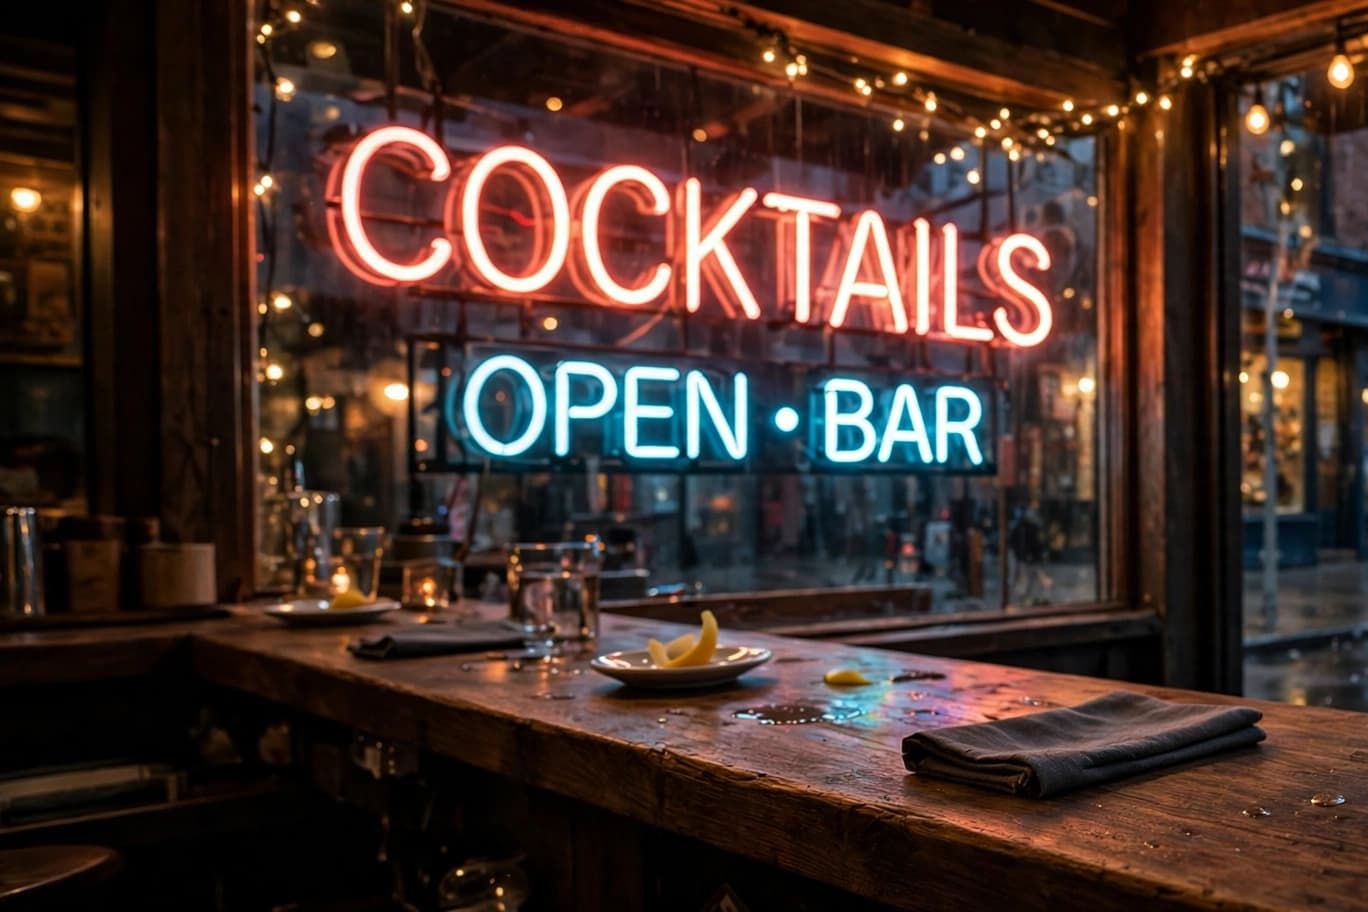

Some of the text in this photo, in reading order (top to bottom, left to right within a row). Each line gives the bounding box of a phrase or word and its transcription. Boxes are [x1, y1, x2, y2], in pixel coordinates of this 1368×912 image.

[335, 125, 1054, 348] COCKTAILS
[462, 353, 749, 460] OPEN
[823, 377, 983, 466] BAR
